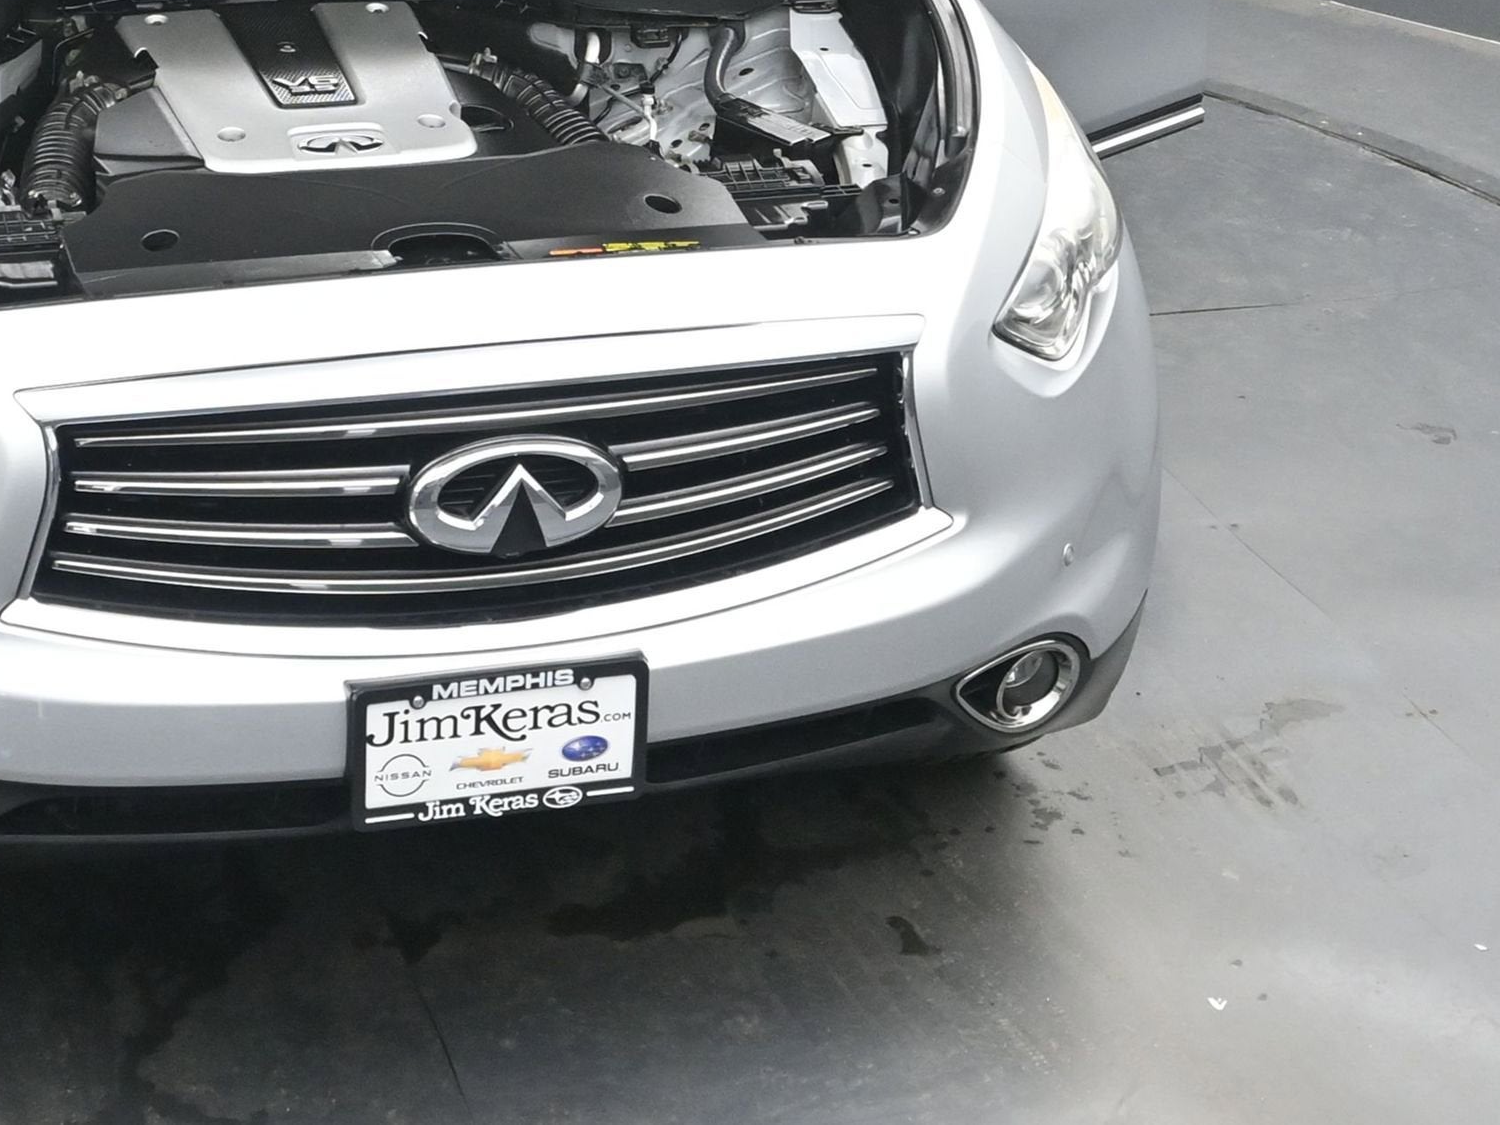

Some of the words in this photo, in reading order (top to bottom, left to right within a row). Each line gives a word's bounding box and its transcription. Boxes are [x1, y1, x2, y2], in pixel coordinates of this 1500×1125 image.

[432, 669, 574, 700] MEMPHIS
[373, 769, 432, 782] NISSAN
[547, 763, 619, 779] SUBARU
[456, 776, 524, 790] CHEVROLET
[417, 800, 465, 821] Jim
[469, 793, 539, 817] Keras
